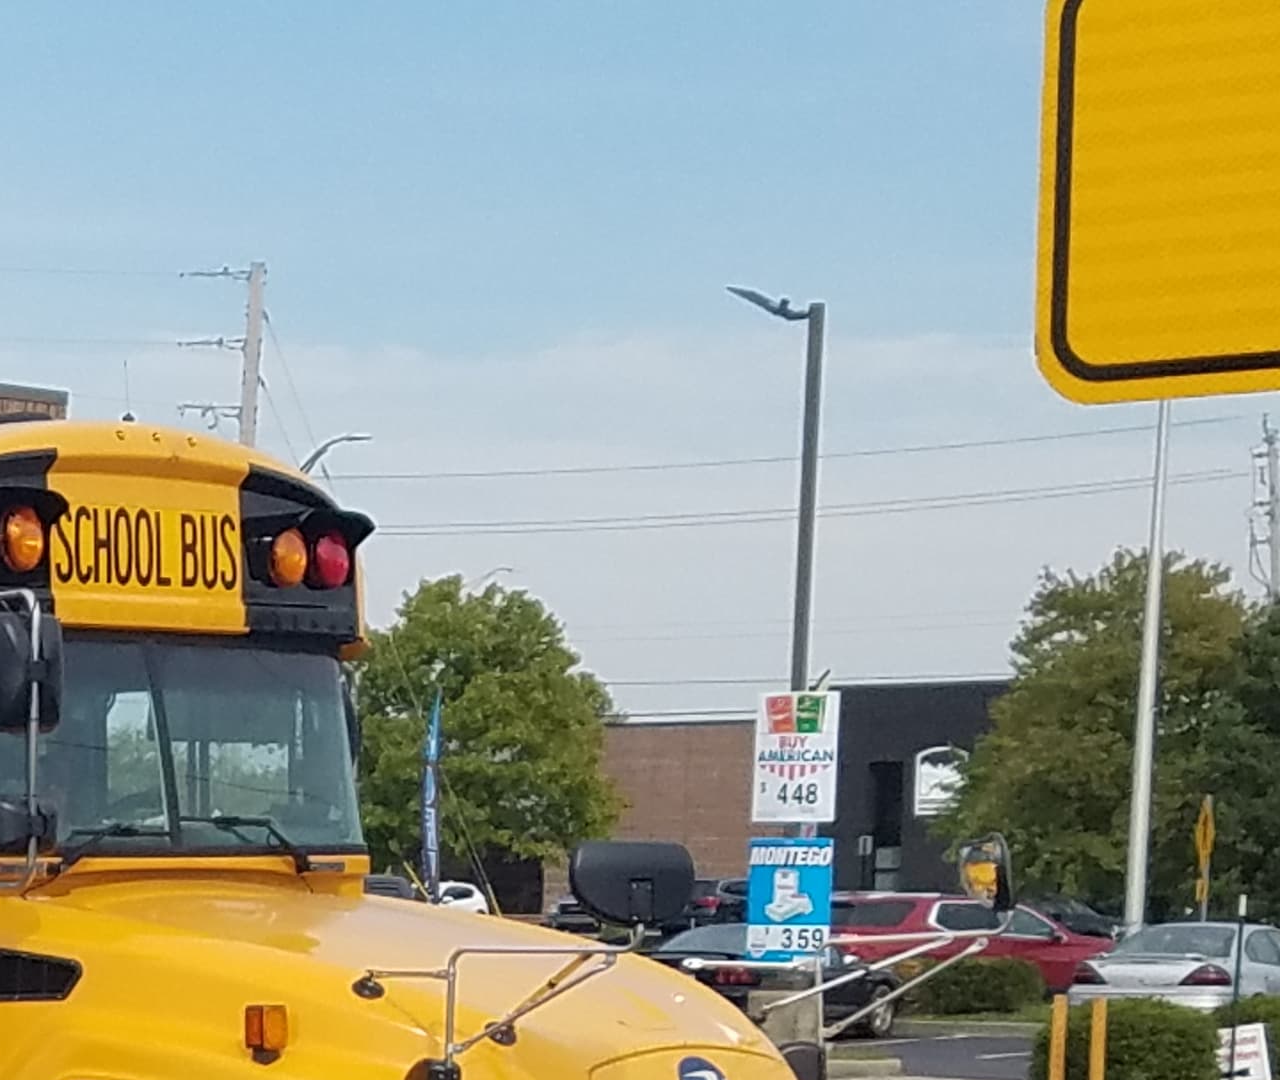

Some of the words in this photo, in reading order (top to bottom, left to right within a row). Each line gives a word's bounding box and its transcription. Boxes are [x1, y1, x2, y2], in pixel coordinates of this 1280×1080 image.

[55, 506, 171, 587] SCHOOL
[180, 513, 237, 590] BUS
[778, 735, 808, 749] BUY
[758, 749, 834, 762] AMERICAN
[777, 783, 819, 805] 448
[749, 846, 832, 866] MONTEGO
[781, 928, 824, 949] 359
